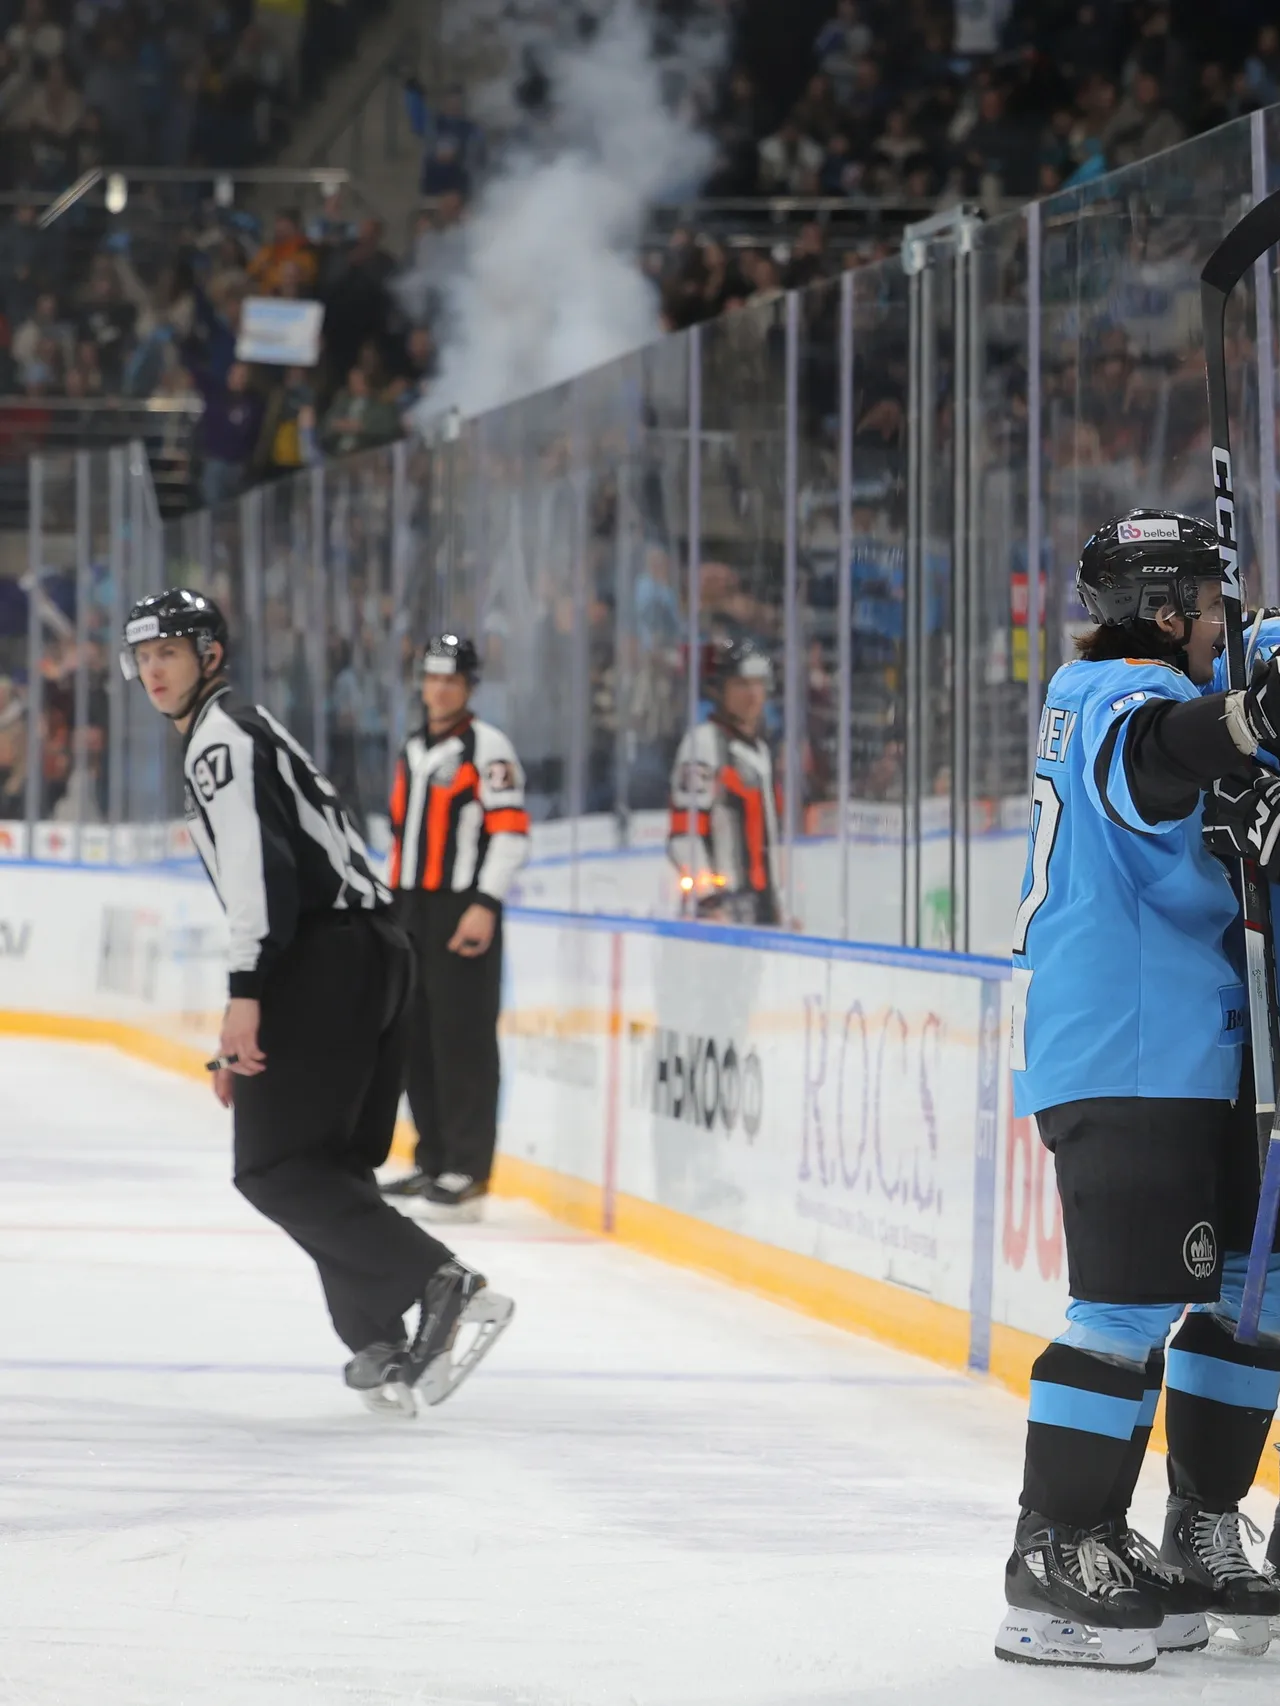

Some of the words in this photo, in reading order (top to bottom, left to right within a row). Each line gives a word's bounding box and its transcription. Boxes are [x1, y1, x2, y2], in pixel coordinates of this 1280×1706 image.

[1211, 444, 1241, 600] CCM
[1143, 527, 1178, 539] belbet
[1142, 566, 1179, 574] CCM
